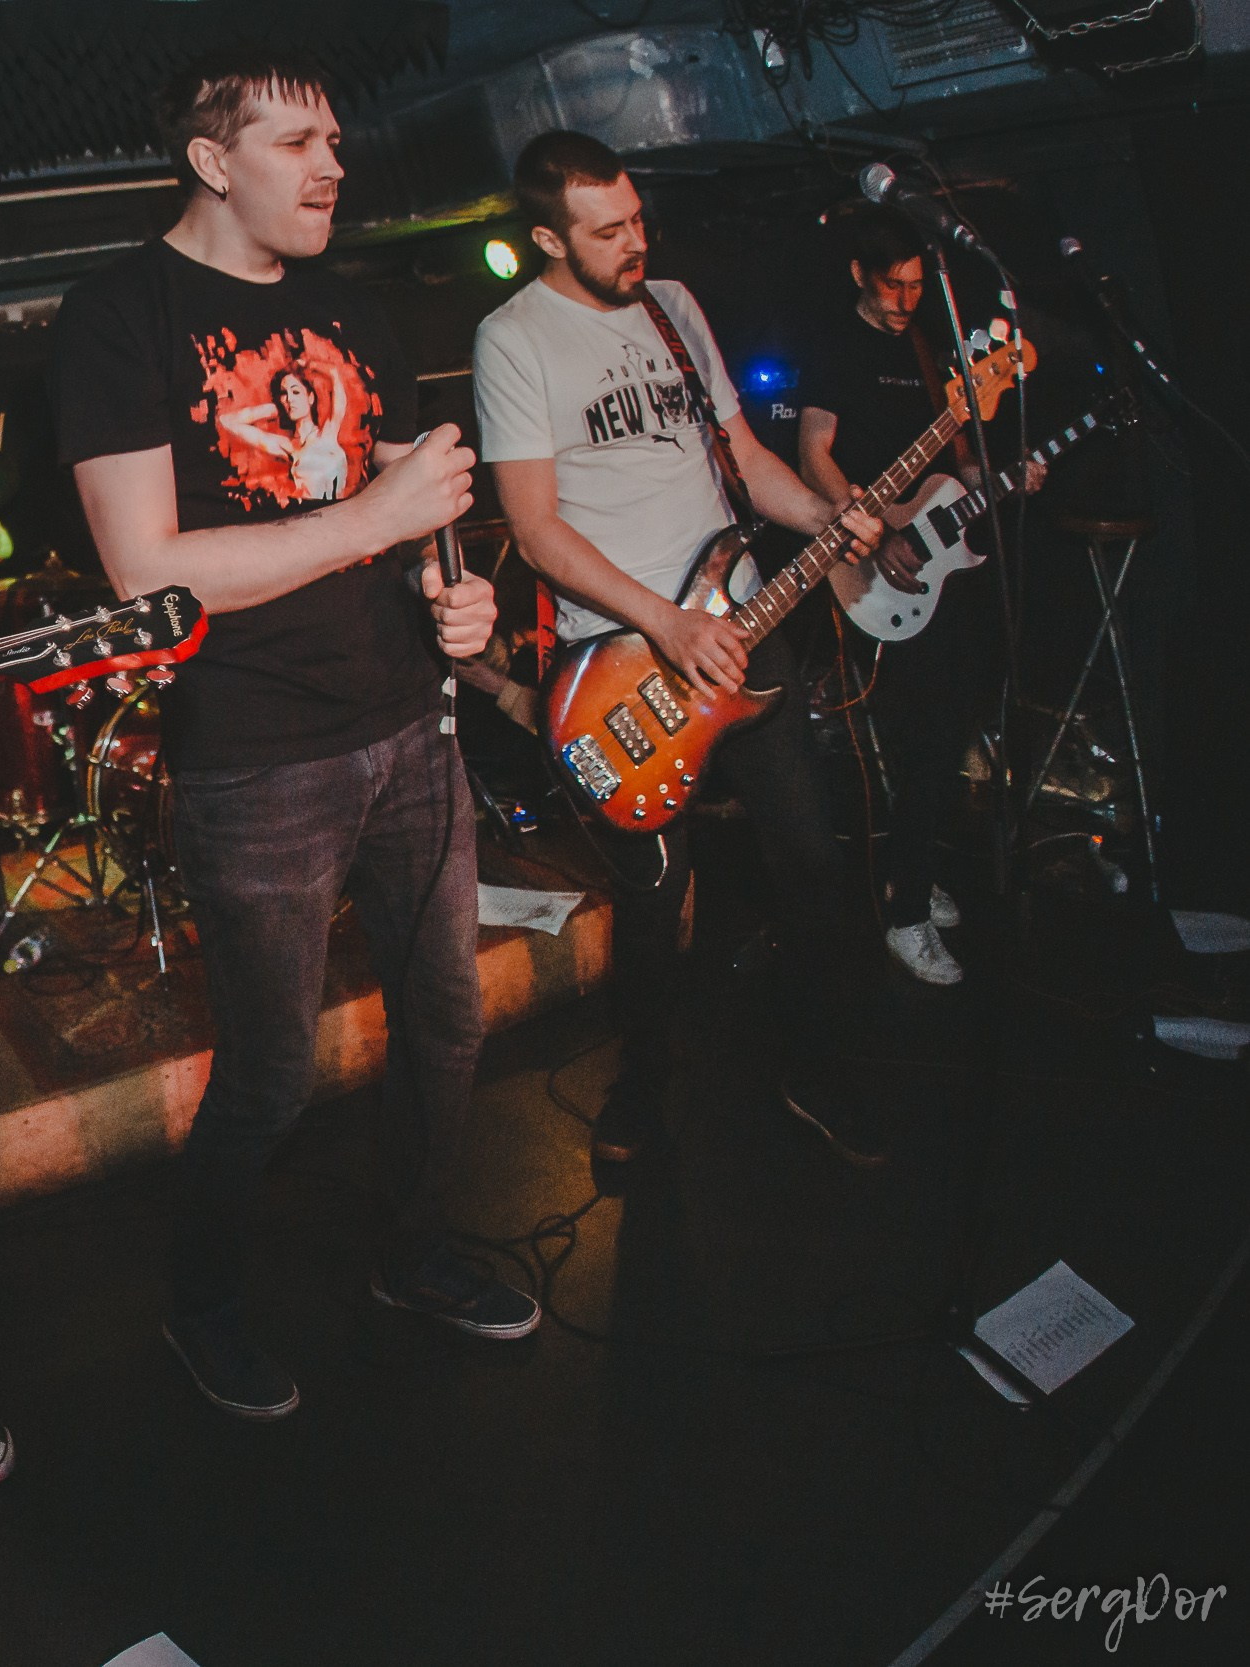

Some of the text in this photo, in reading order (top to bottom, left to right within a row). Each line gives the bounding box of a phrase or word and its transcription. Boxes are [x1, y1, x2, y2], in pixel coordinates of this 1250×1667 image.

[605, 358, 673, 382] PUMA
[585, 385, 645, 444] NEW
[161, 592, 183, 637] Epiphone
